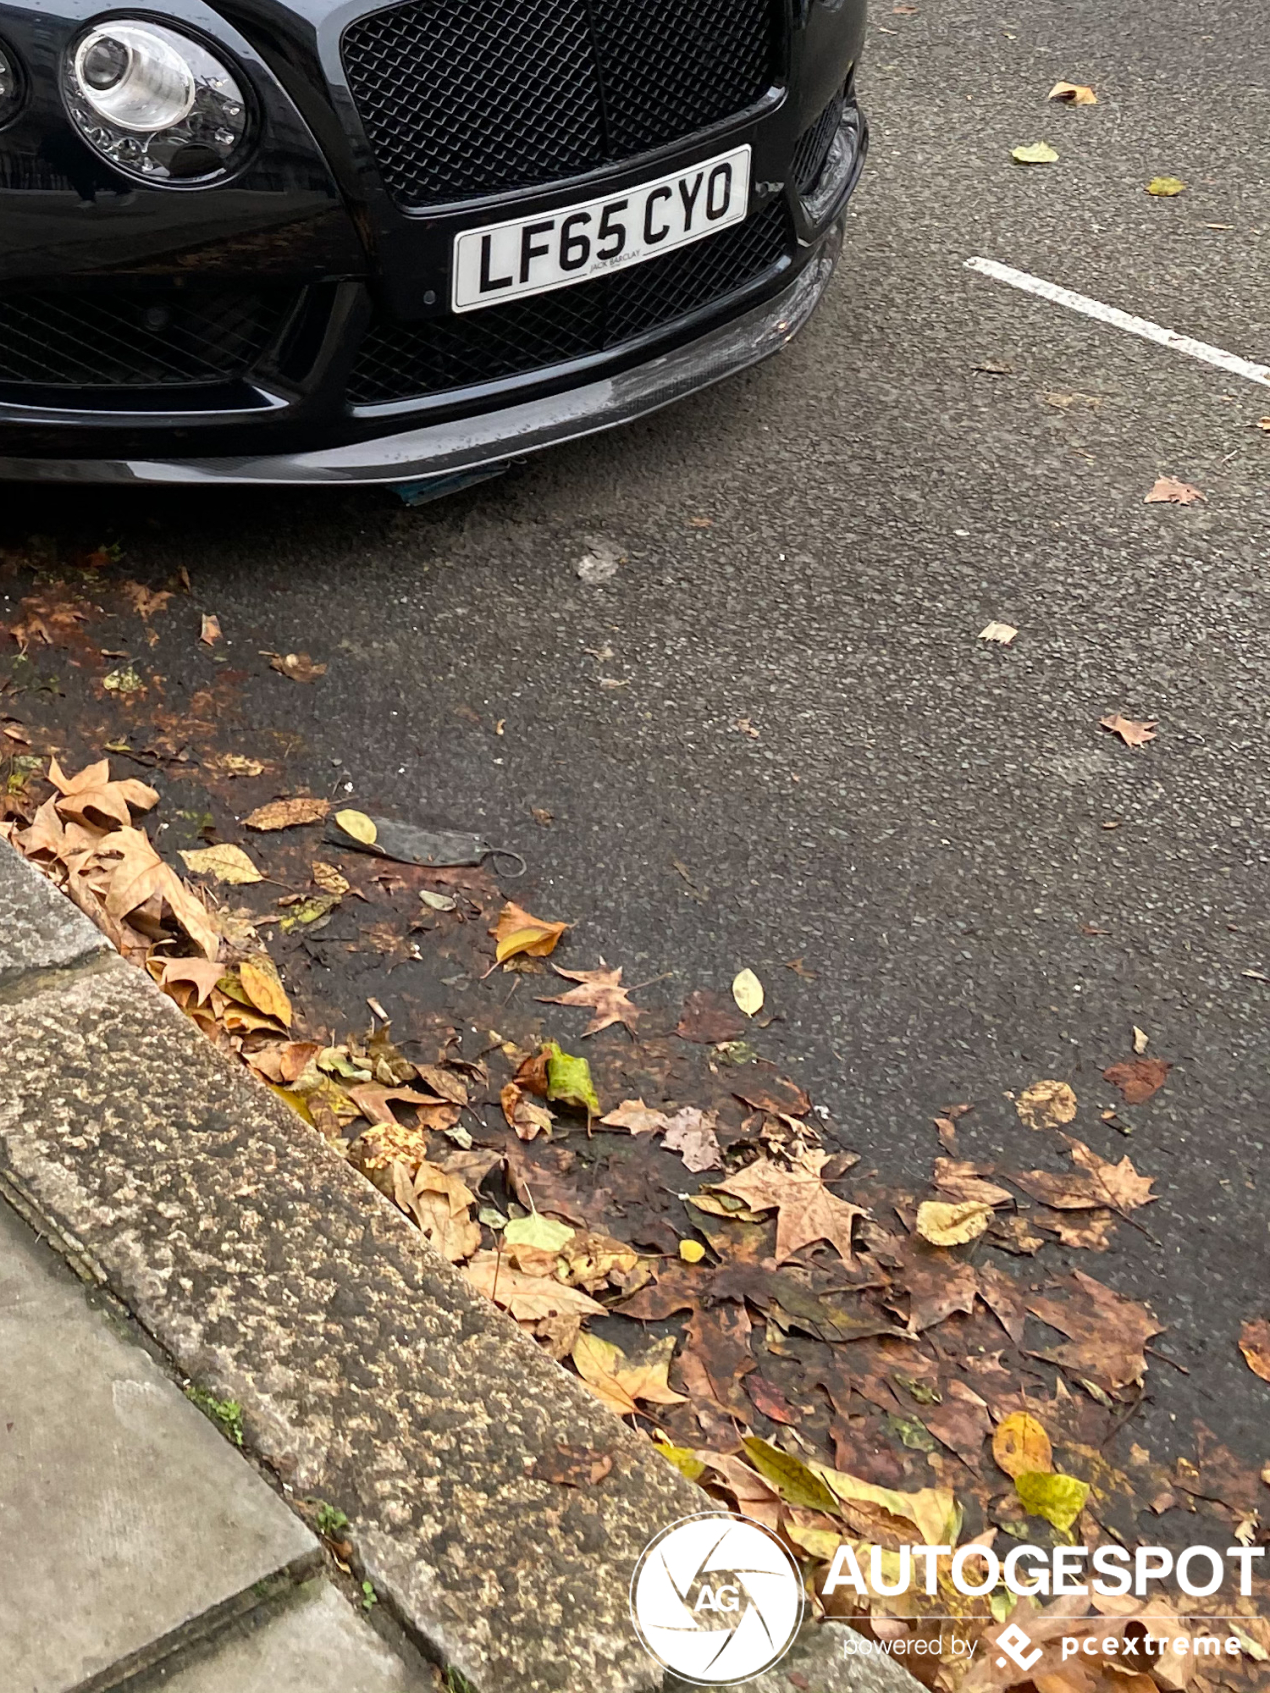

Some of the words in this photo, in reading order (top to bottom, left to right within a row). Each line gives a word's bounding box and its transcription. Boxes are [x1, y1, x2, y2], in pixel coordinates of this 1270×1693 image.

[479, 198, 629, 294] LF65
[643, 162, 733, 246] CYO
[589, 261, 608, 274] JACK
[609, 249, 641, 267] BARCLAY
